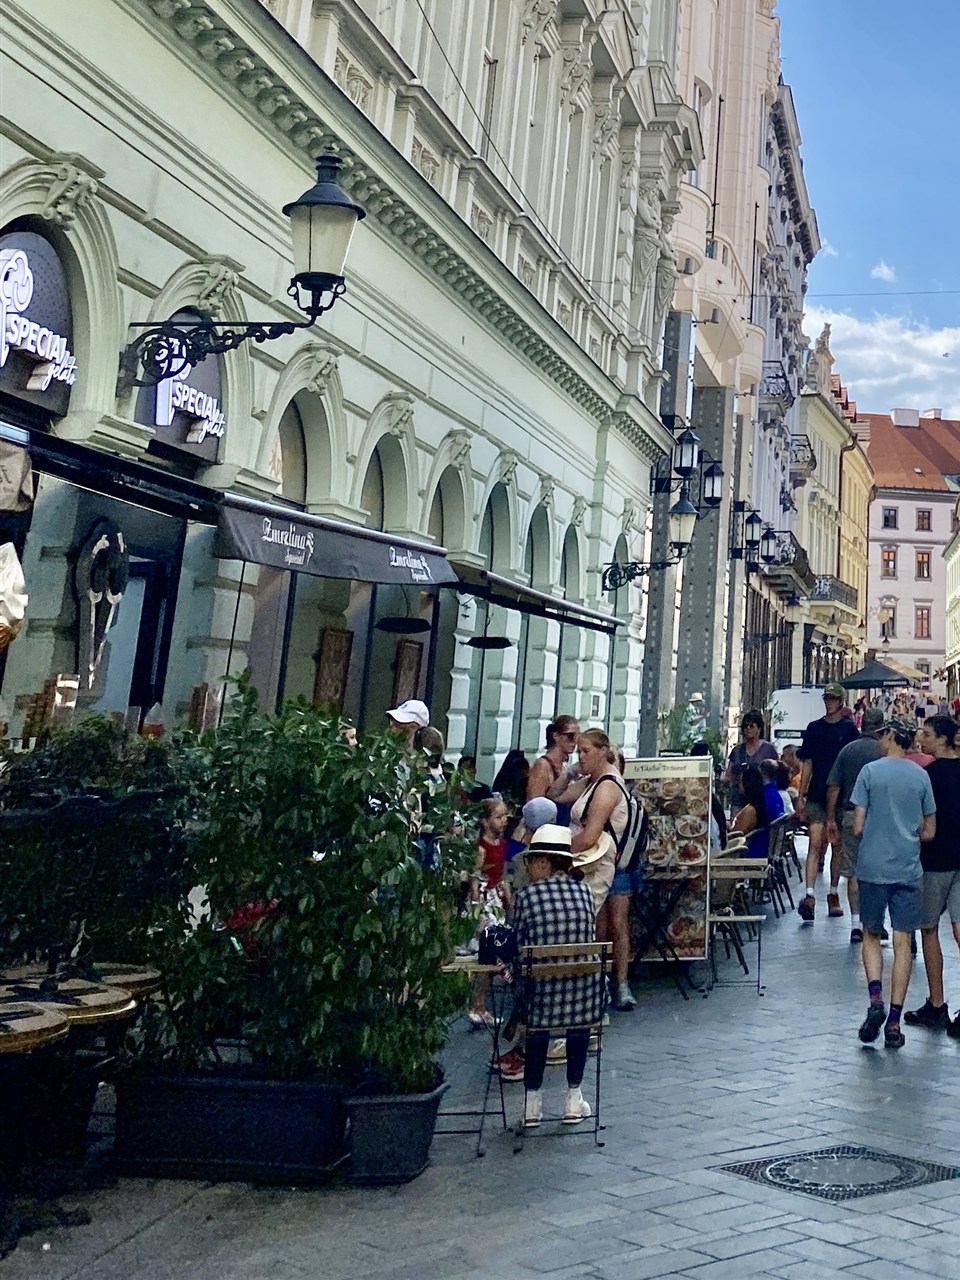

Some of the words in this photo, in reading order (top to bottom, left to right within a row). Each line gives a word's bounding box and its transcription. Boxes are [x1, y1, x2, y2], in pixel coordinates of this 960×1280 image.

[6, 314, 68, 365] SPECIAL
[41, 351, 79, 392] gelato
[172, 381, 218, 421] SPECIAL
